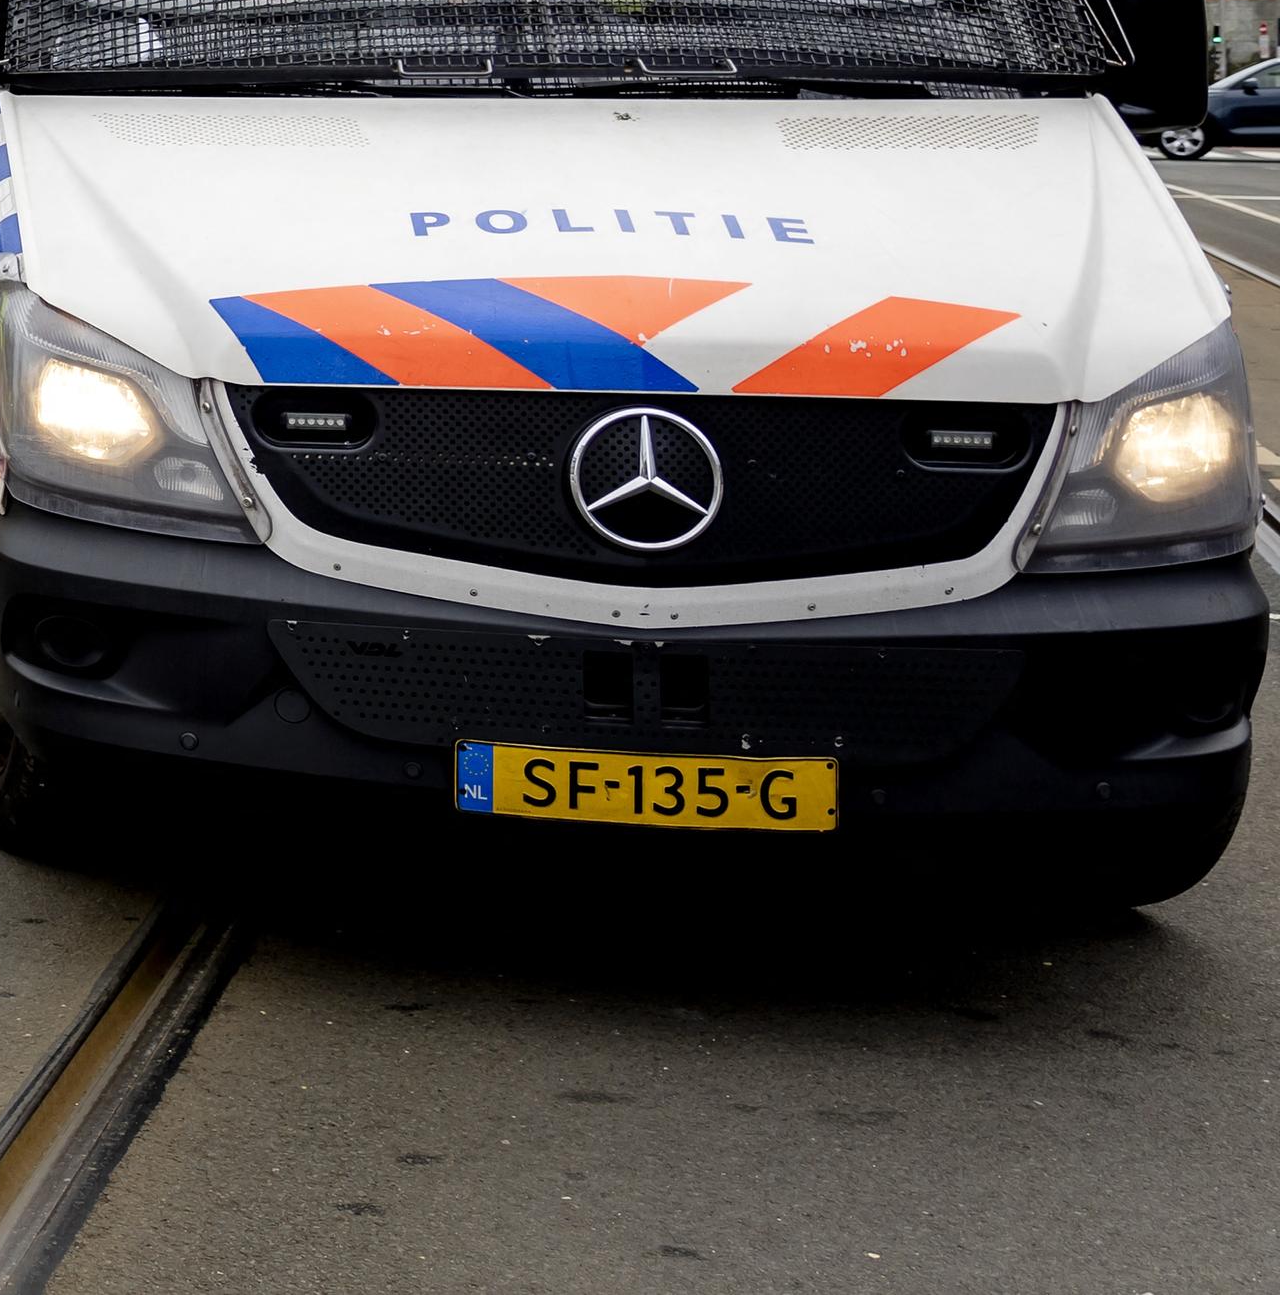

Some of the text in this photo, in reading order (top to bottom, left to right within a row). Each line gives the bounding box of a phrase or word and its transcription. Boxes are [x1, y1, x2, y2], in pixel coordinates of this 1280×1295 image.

[409, 209, 815, 244] POLITIE
[464, 758, 798, 820] NL SF-135-G
